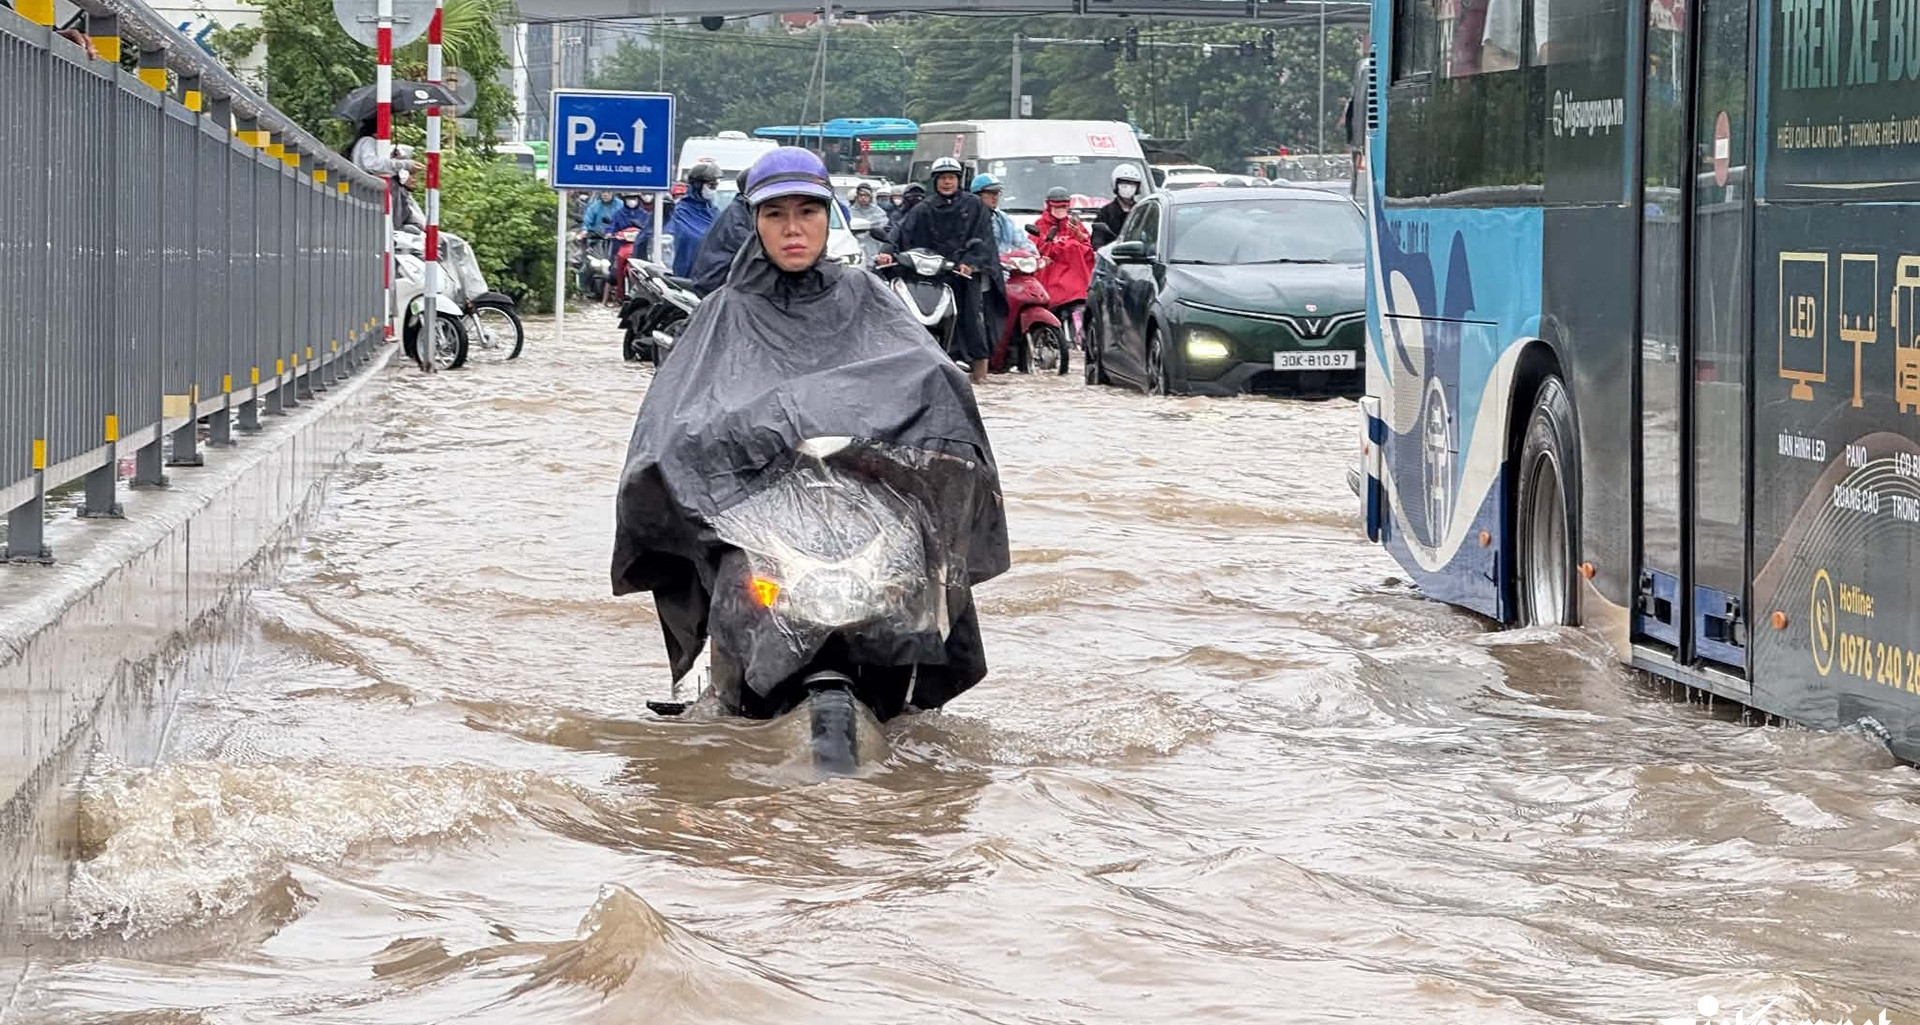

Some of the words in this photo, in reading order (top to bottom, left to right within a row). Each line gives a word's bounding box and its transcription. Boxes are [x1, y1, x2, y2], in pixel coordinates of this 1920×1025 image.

[1847, 0, 1879, 85] XE
[1564, 89, 1623, 137] bigsungroup.vn
[567, 115, 596, 156] P
[1812, 124, 1826, 148] LAN
[1849, 118, 1880, 147] THƯƠNG
[1881, 113, 1901, 150] HIỆU
[573, 163, 594, 172] AEON
[595, 164, 615, 173] MALL
[615, 165, 634, 173] LONG
[1789, 295, 1815, 338] LED
[1281, 354, 1349, 367] 30K-810.97
[1778, 428, 1793, 456] MÀN
[1794, 431, 1811, 460] HÌNH
[1811, 439, 1826, 462] LED
[1846, 444, 1867, 469] PANO
[1895, 451, 1911, 476] LCD
[1862, 485, 1880, 515] CÁO
[1892, 495, 1920, 523] TRONG
[1840, 582, 1875, 618] Hotline:
[1840, 632, 1873, 680] 0976
[1877, 642, 1902, 689] 240
